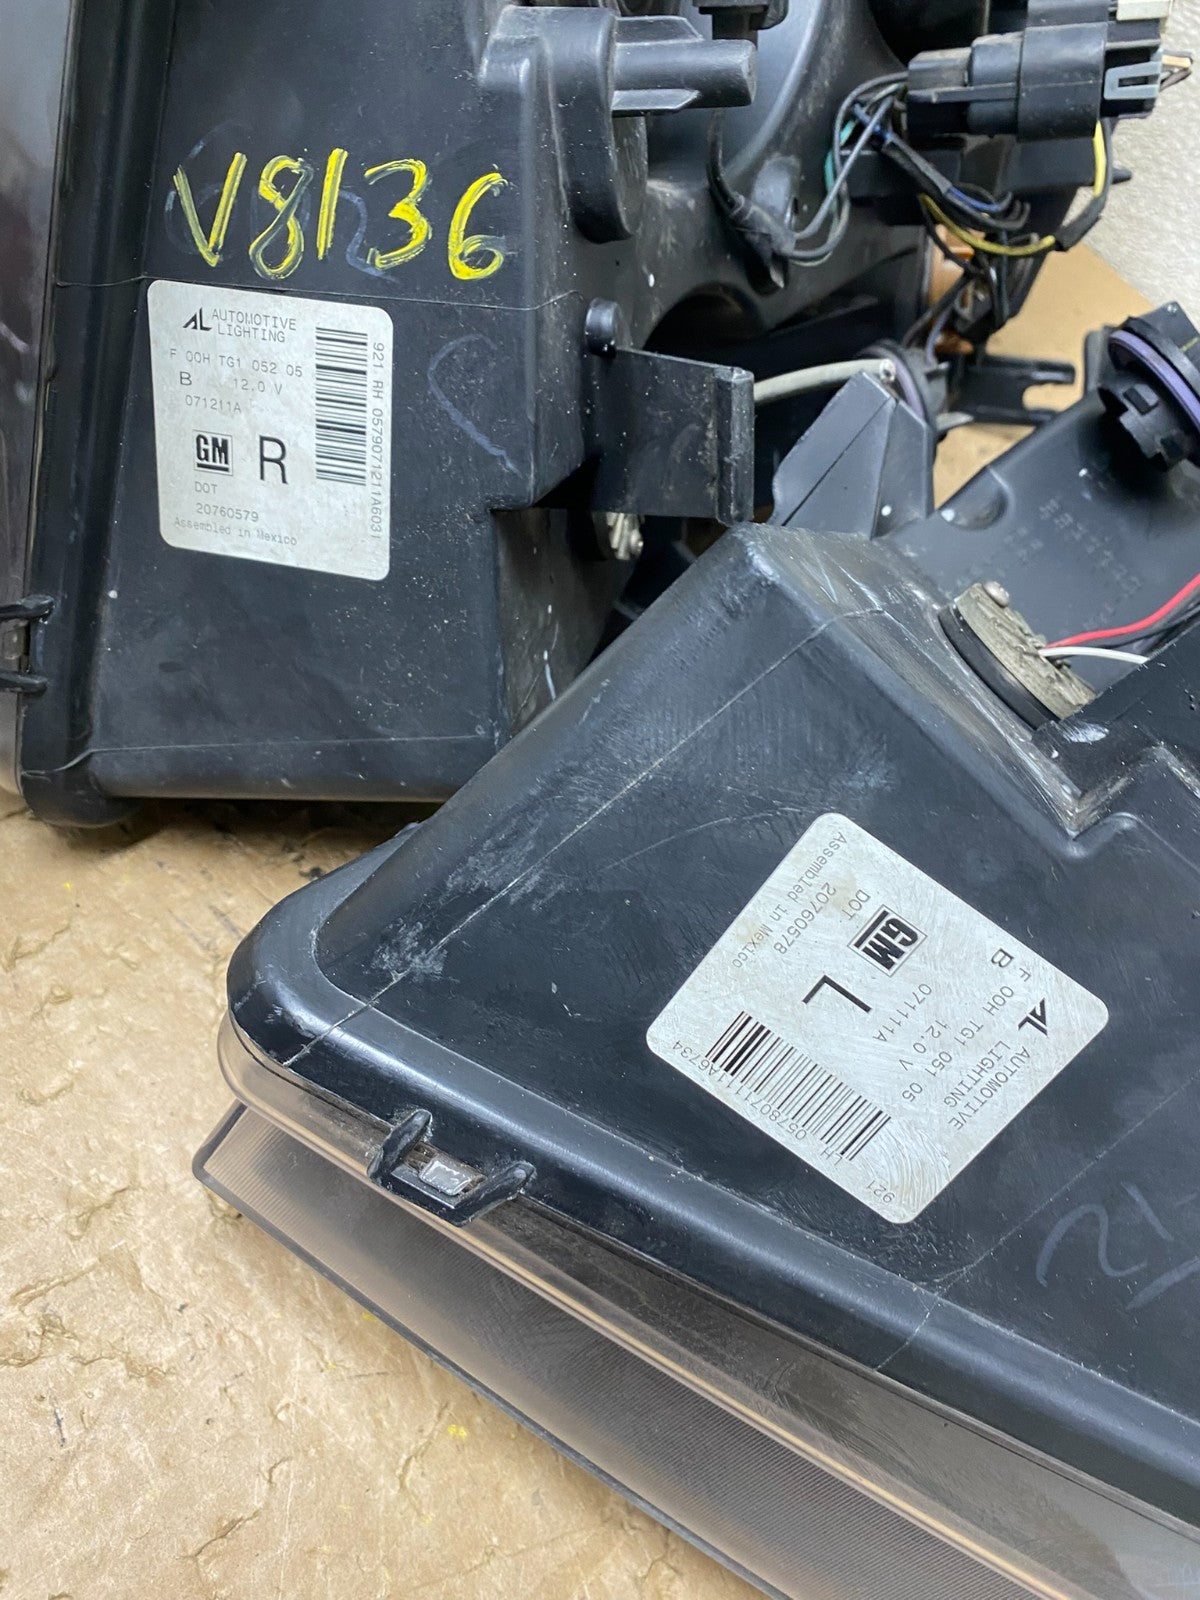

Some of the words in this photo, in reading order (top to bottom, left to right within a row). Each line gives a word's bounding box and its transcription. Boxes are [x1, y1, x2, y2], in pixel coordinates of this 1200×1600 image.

[173, 148, 508, 280] V8136
[212, 308, 297, 331] AUTOMOTIVE
[218, 323, 286, 343] LIGHTING
[169, 348, 177, 359] F
[219, 355, 241, 368] TG1
[252, 360, 277, 374] 052
[286, 364, 303, 377] 05
[372, 342, 385, 369] 921
[180, 371, 192, 386] B
[234, 378, 265, 393] 12.0
[274, 383, 283, 395] V
[372, 380, 384, 400] RH
[185, 394, 242, 414] 071211A
[195, 433, 229, 465] GM
[259, 435, 288, 484] R
[194, 481, 218, 494] DOT
[196, 502, 259, 523] 20760579
[174, 517, 231, 536] Assembled
[238, 528, 251, 538] in
[256, 529, 298, 546] Mexico
[787, 831, 848, 901] Assembled
[769, 904, 788, 922] in
[841, 889, 871, 921] DOT
[773, 882, 837, 955] 20760578
[732, 923, 774, 968] Mexico
[861, 917, 919, 971] GM
[990, 948, 1014, 968] B
[1019, 967, 1031, 982] F
[802, 974, 872, 1014] L
[872, 983, 932, 1042] 071111A
[912, 1019, 951, 1054] 12.0
[954, 1020, 984, 1046] TG1
[898, 1058, 914, 1071] V
[924, 1051, 953, 1077] 051
[943, 1040, 1011, 1108] LIGHTING
[901, 1082, 923, 1103] 05
[948, 1045, 1031, 1130] AUTOMOTIVE
[820, 1146, 843, 1166] LH
[866, 1179, 896, 1203] 921
